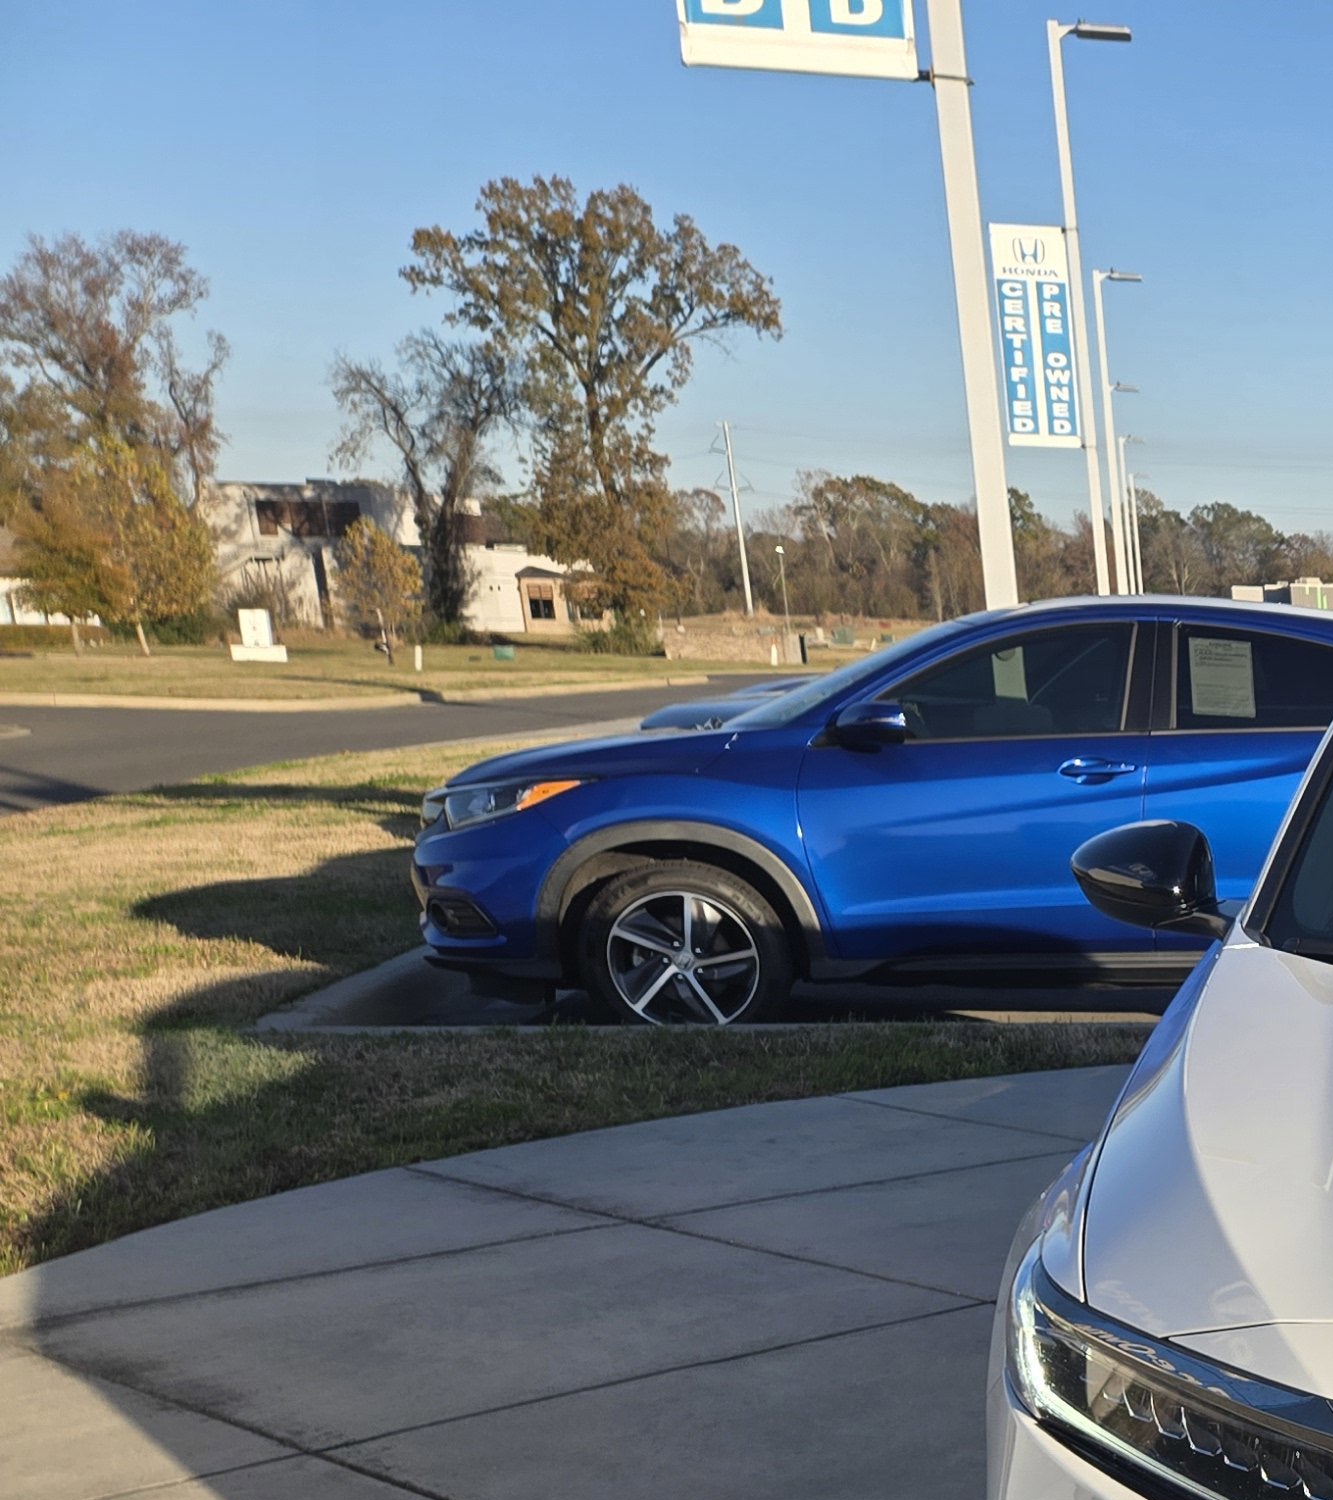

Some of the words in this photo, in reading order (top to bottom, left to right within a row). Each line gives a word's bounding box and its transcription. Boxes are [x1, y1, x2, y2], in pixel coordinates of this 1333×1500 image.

[1002, 266, 1059, 278] HONDA
[1042, 283, 1064, 335] PRE
[1001, 281, 1035, 433] CERTIFIED
[1045, 352, 1072, 435] OWNED
